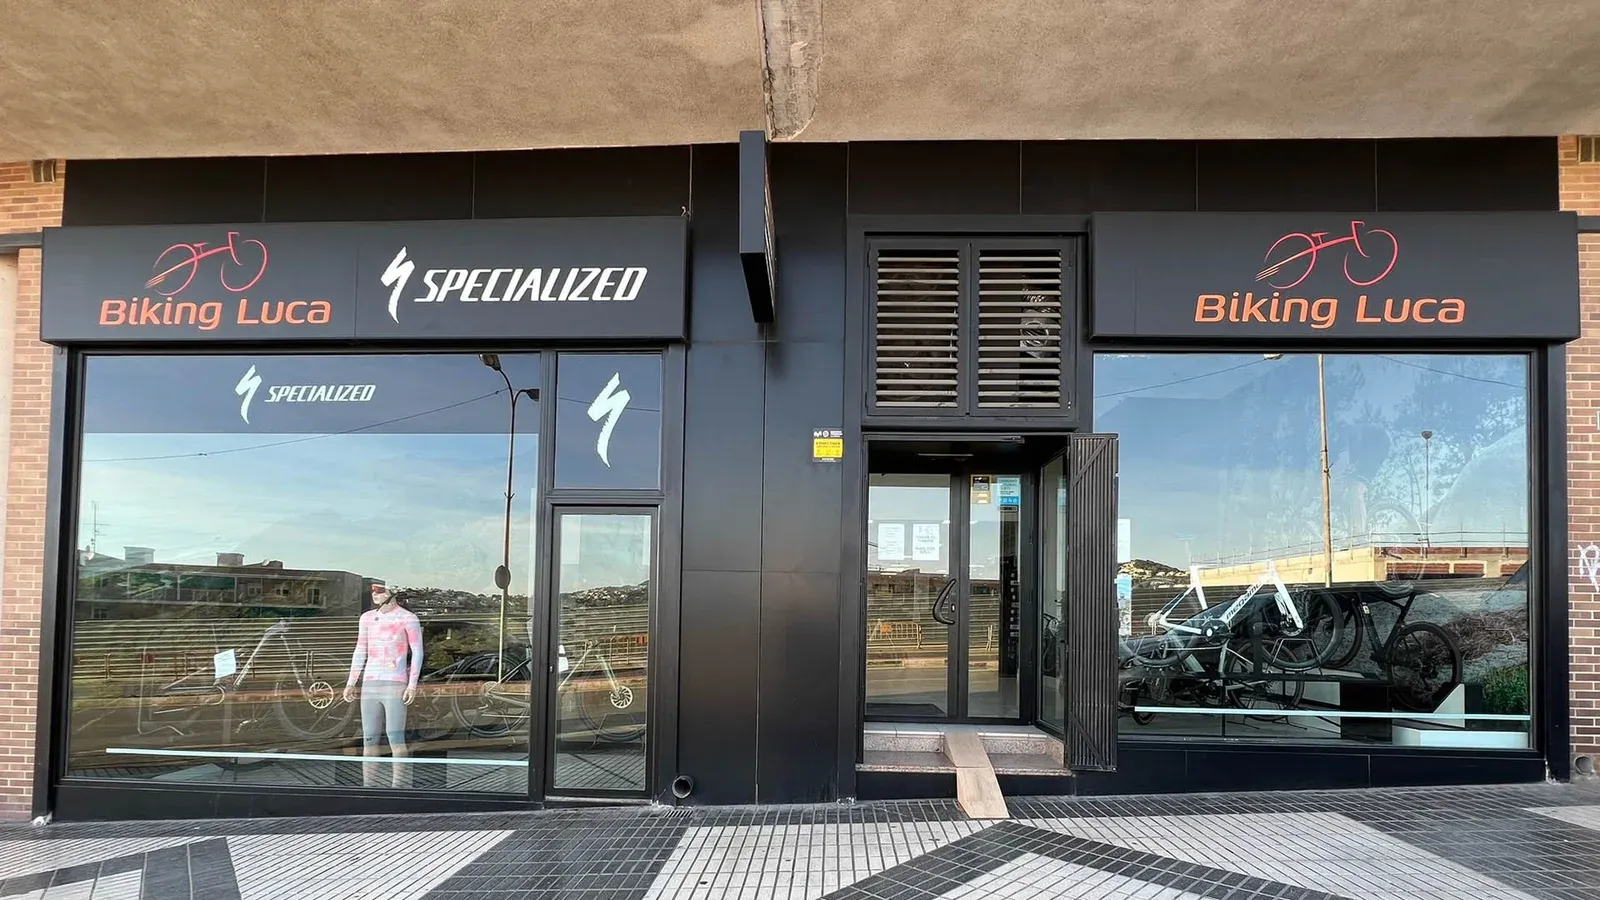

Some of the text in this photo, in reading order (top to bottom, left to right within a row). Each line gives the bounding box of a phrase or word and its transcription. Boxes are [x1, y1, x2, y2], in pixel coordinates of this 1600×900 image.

[415, 265, 648, 303] SPECIALIZED
[99, 298, 332, 329] Biking Luca
[1195, 292, 1466, 329] Biking Luca
[264, 384, 377, 404] SPECIALIZED
